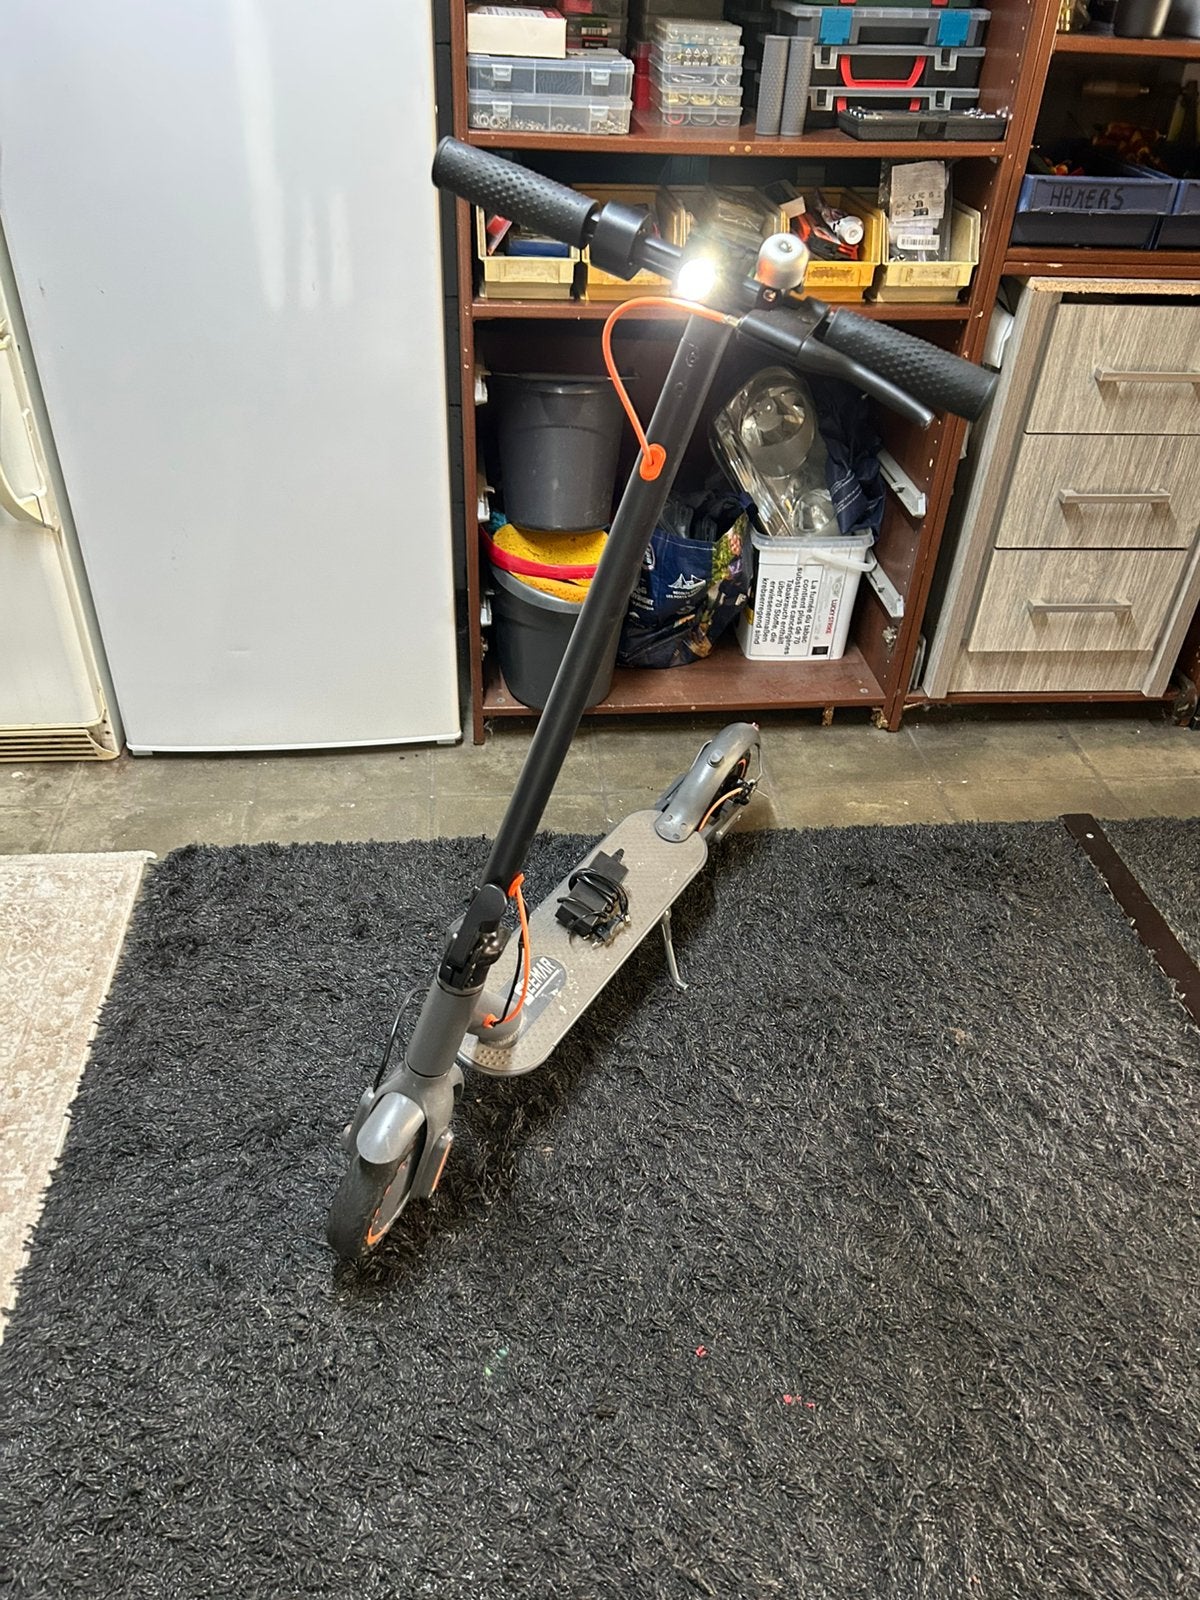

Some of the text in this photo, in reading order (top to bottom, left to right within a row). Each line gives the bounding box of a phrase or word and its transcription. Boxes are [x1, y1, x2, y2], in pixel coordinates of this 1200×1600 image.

[756, 578, 769, 628] krebserregend
[791, 568, 802, 608] substances
[800, 579, 809, 610] contient
[762, 581, 775, 642] erwiesenermaßen
[778, 580, 794, 644] Tabakrauch enthält
[795, 626, 802, 635] de
[802, 580, 818, 643] La fumée du tabac
[794, 636, 800, 644] 70
